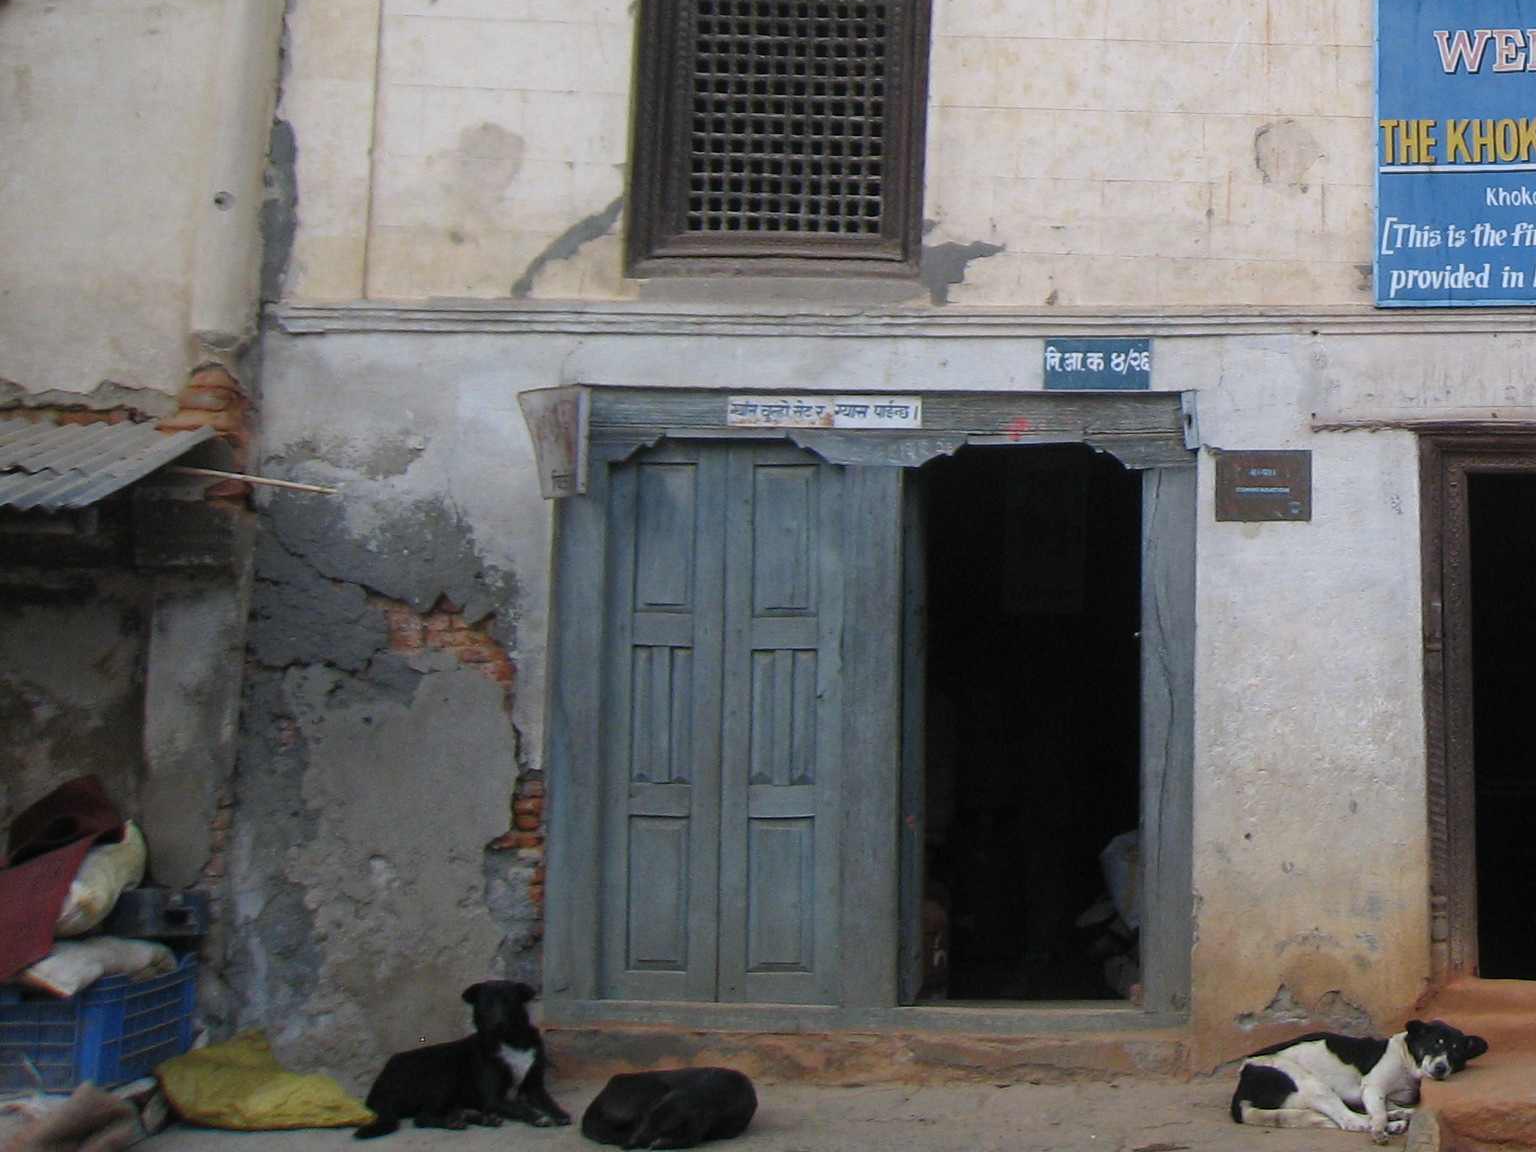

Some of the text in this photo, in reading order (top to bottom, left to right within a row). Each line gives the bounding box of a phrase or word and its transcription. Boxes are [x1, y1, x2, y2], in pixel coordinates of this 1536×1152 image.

[1380, 119, 1437, 165] THE
[1447, 224, 1467, 248] is
[1471, 222, 1508, 248] the
[1390, 263, 1491, 298] provided
[1502, 265, 1524, 288] in
